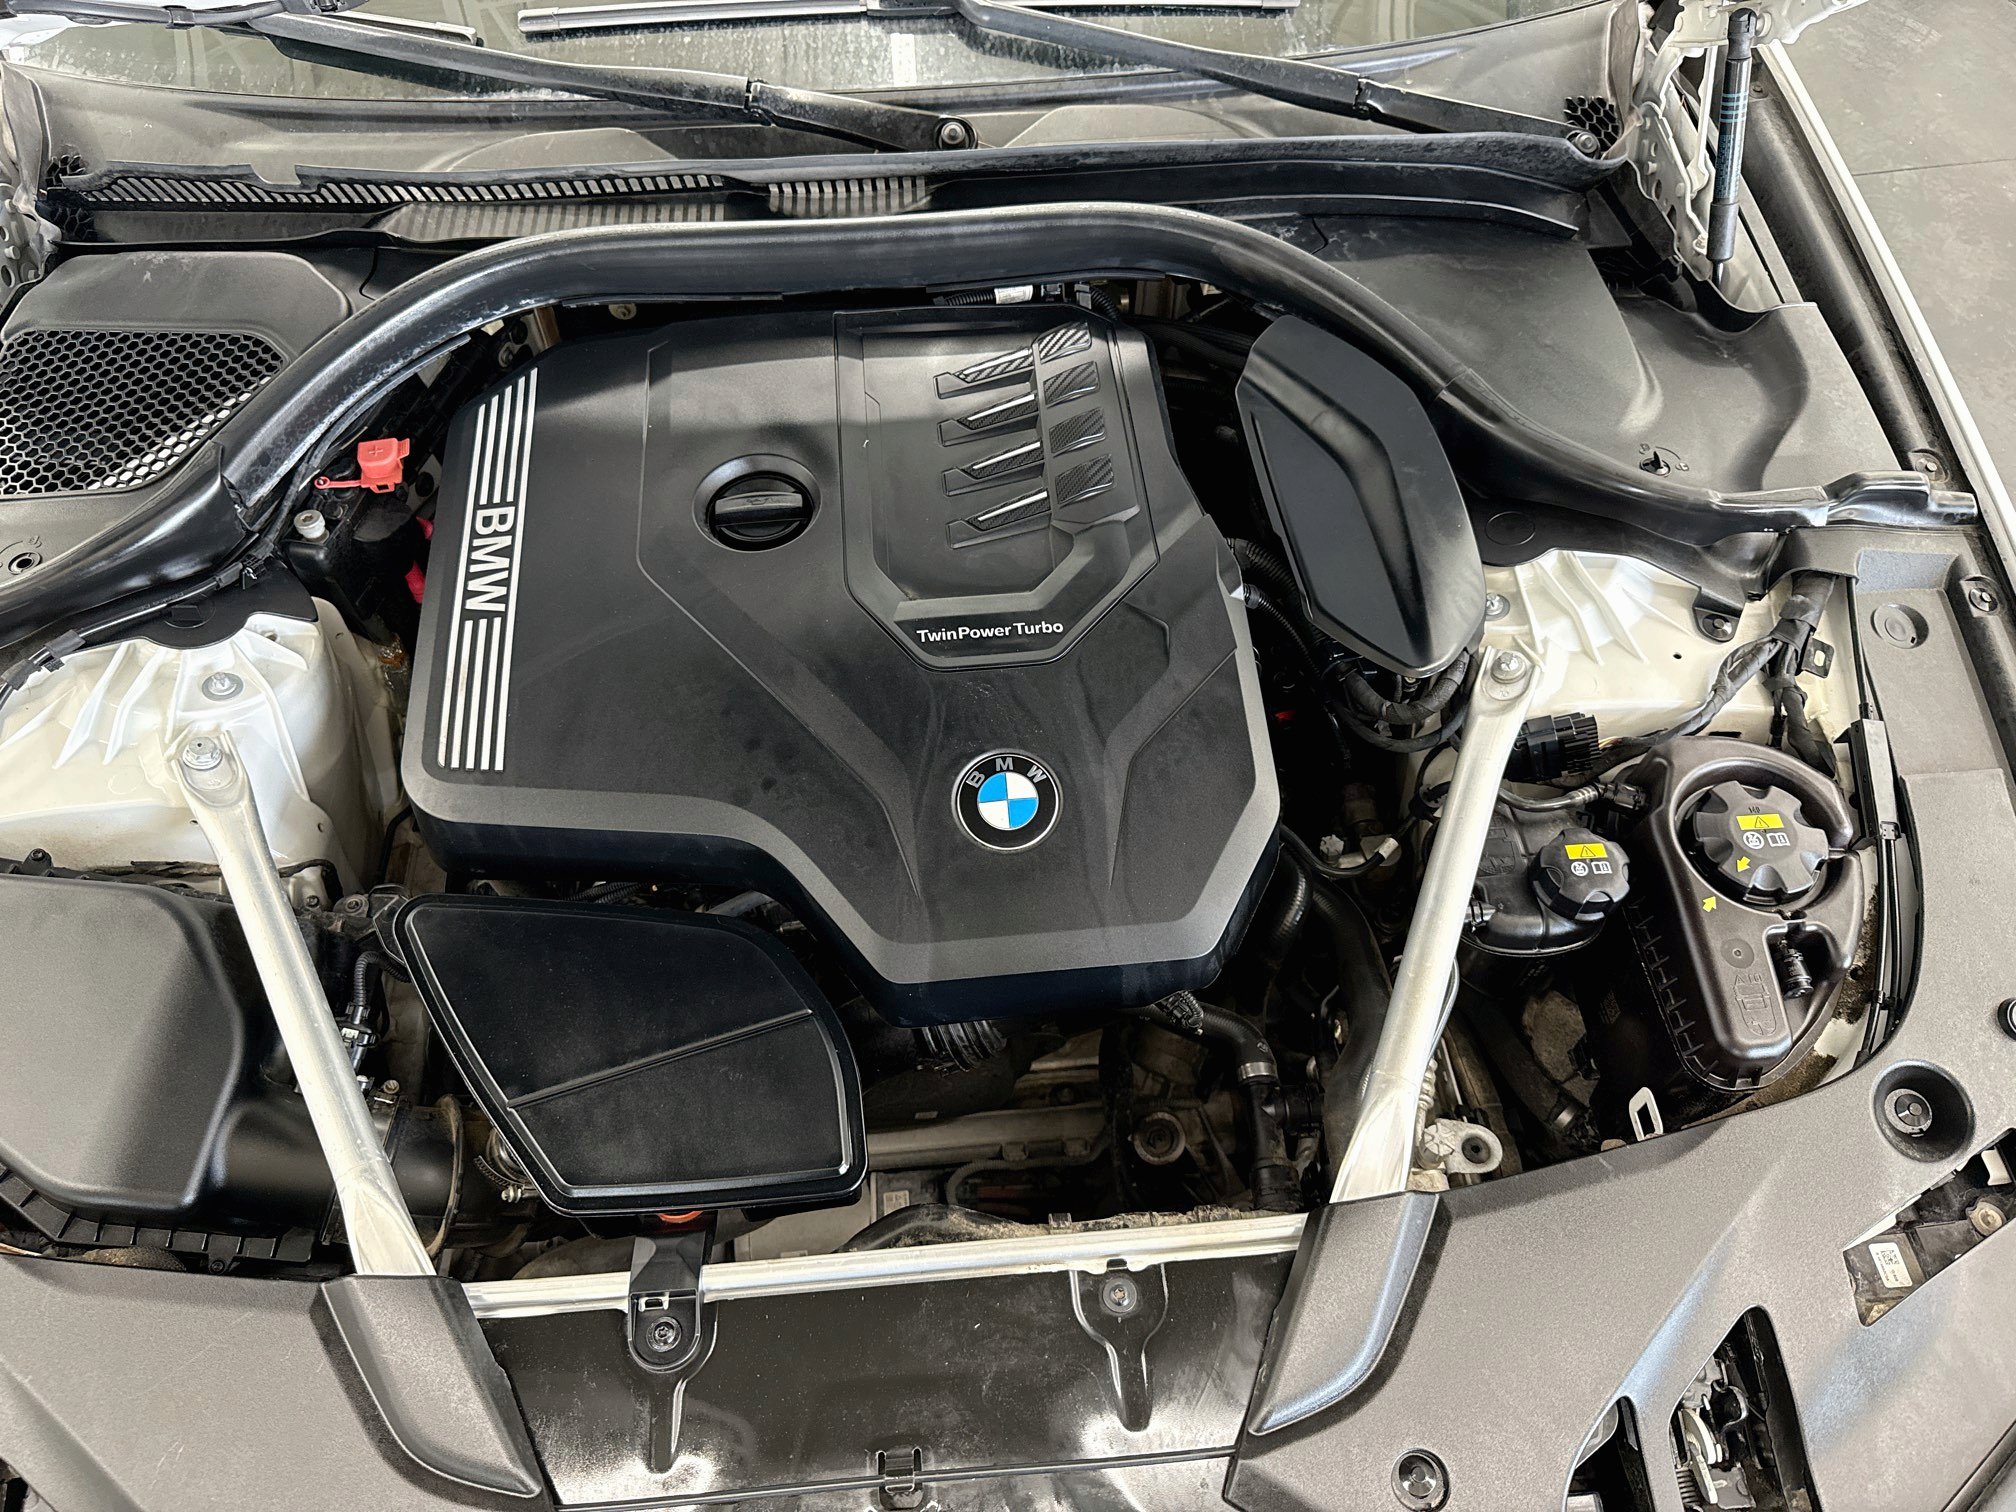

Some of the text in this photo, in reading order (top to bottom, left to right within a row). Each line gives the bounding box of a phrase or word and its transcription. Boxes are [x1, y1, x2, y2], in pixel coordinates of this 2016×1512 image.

[465, 506, 515, 612] BMW
[1013, 620, 1064, 636] Turbo
[965, 757, 1047, 788] BMW
